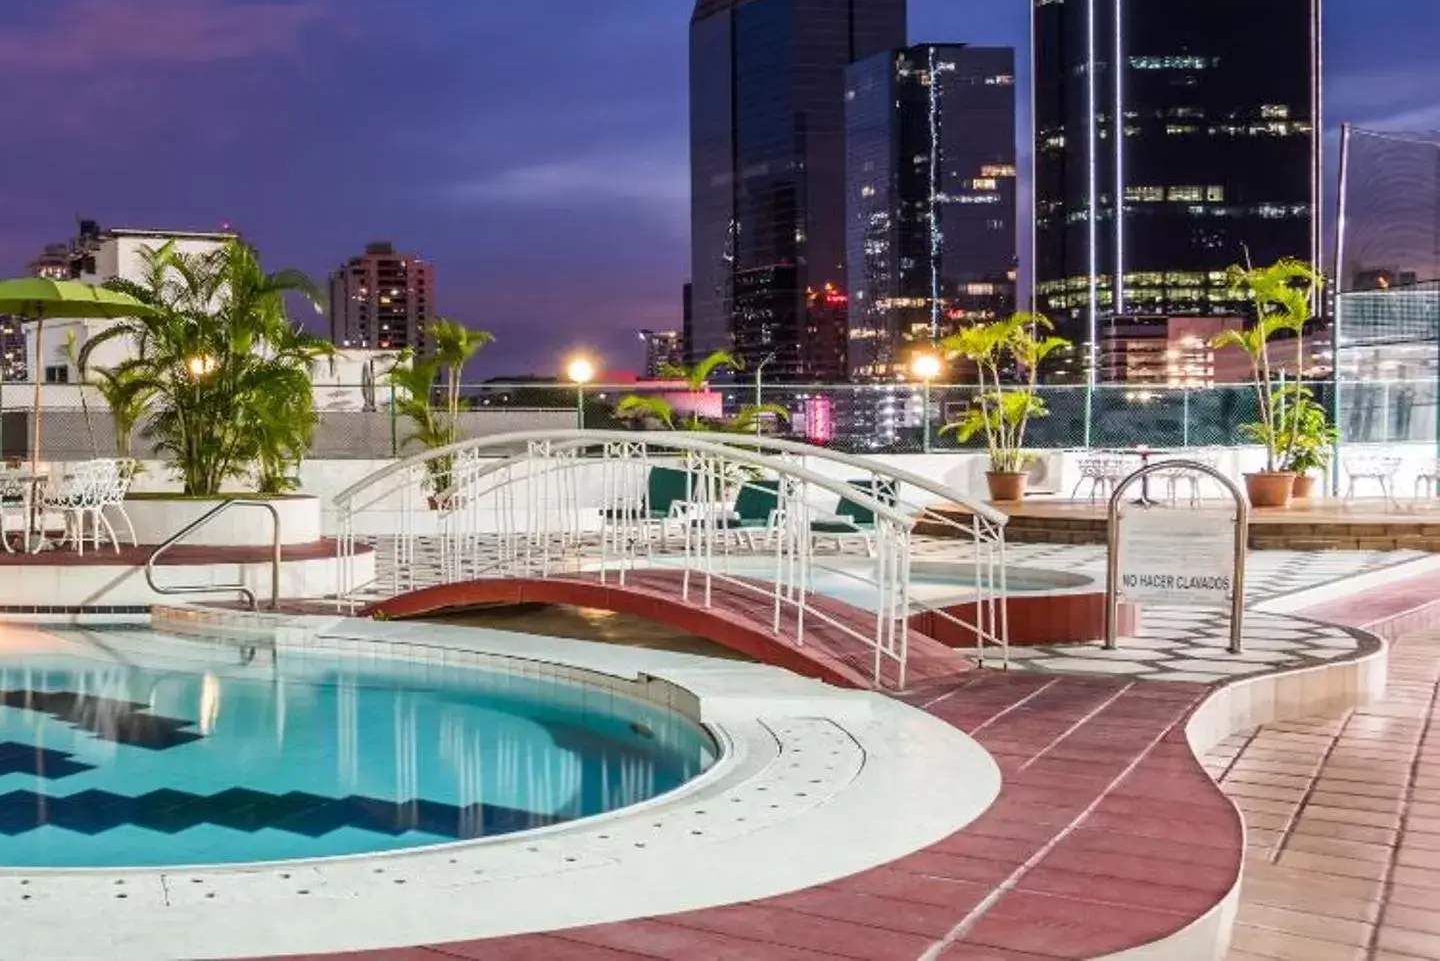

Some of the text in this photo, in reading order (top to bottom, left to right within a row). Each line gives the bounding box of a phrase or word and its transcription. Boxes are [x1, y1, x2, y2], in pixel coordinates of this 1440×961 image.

[1122, 574, 1231, 591] NO HACER CLAVADOS
